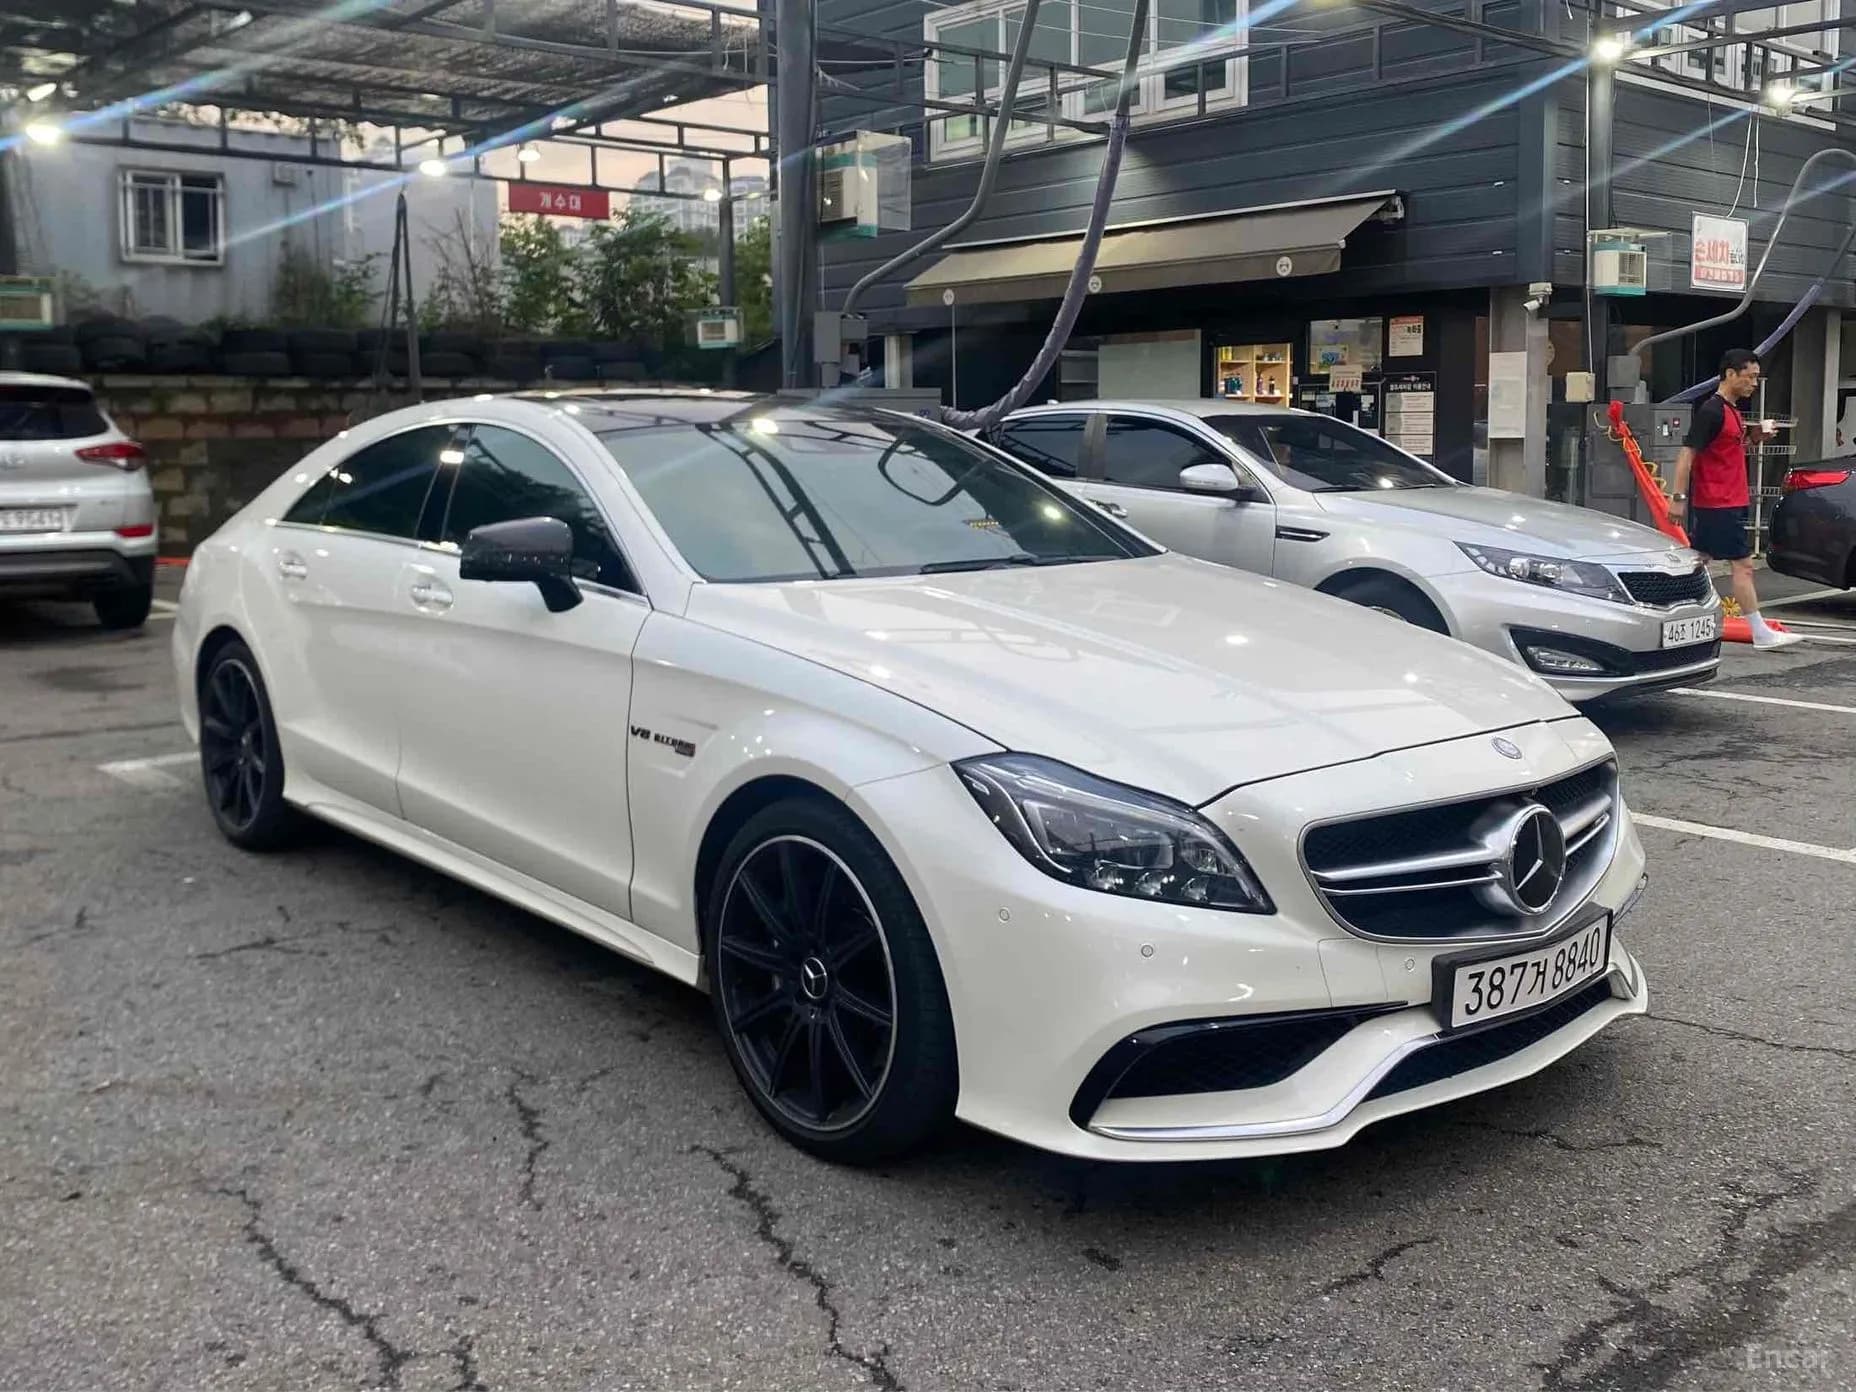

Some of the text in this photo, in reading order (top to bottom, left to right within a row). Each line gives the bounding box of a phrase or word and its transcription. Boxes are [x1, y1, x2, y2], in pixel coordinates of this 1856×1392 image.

[540, 191, 581, 211] 개수대
[1695, 240, 1730, 264] 손세차
[1668, 618, 1711, 642] 46조 1245
[631, 725, 651, 740] V8
[1465, 927, 1601, 1016] 387거 8840
